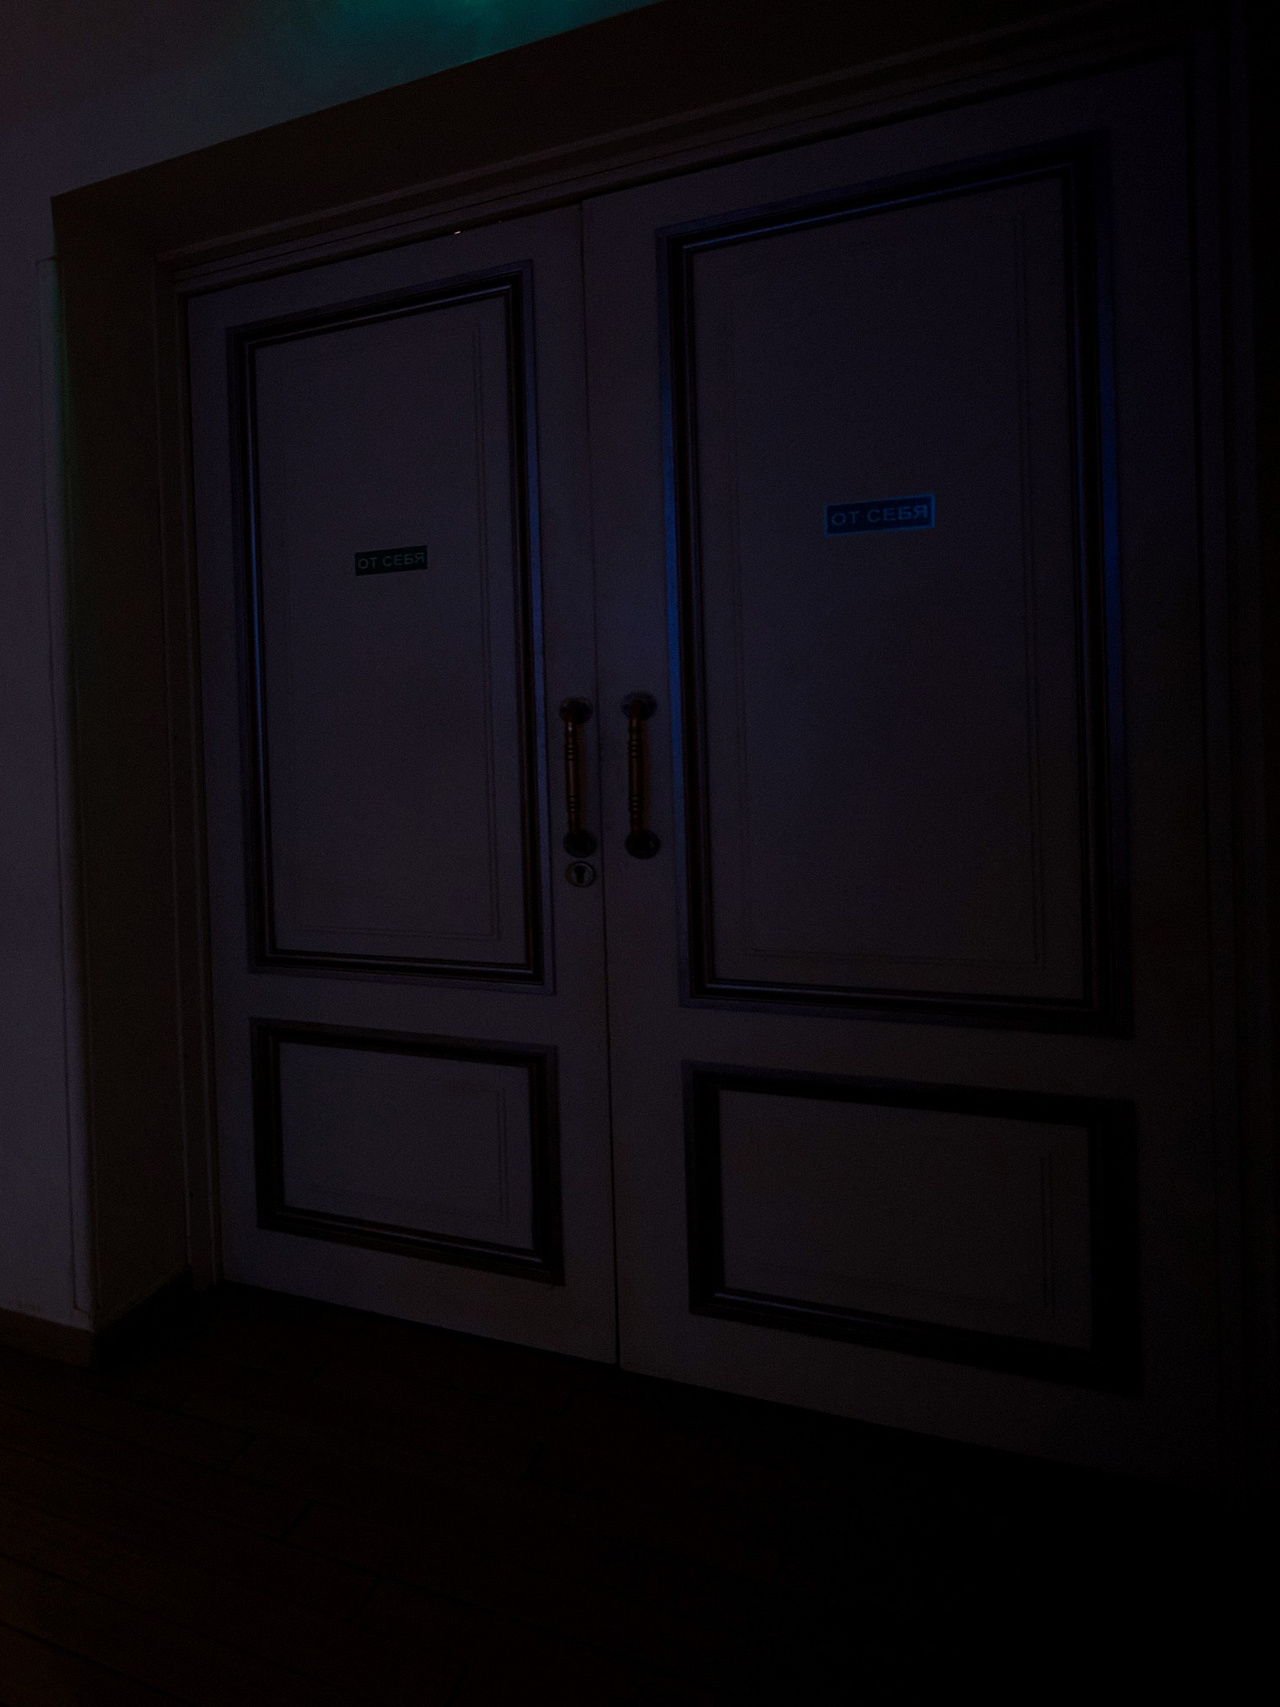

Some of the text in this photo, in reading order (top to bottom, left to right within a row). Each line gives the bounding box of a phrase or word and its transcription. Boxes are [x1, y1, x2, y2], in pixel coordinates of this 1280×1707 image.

[831, 504, 928, 526] ОТ СЕБЯ
[358, 552, 425, 570] ОТ СЕБЯ
